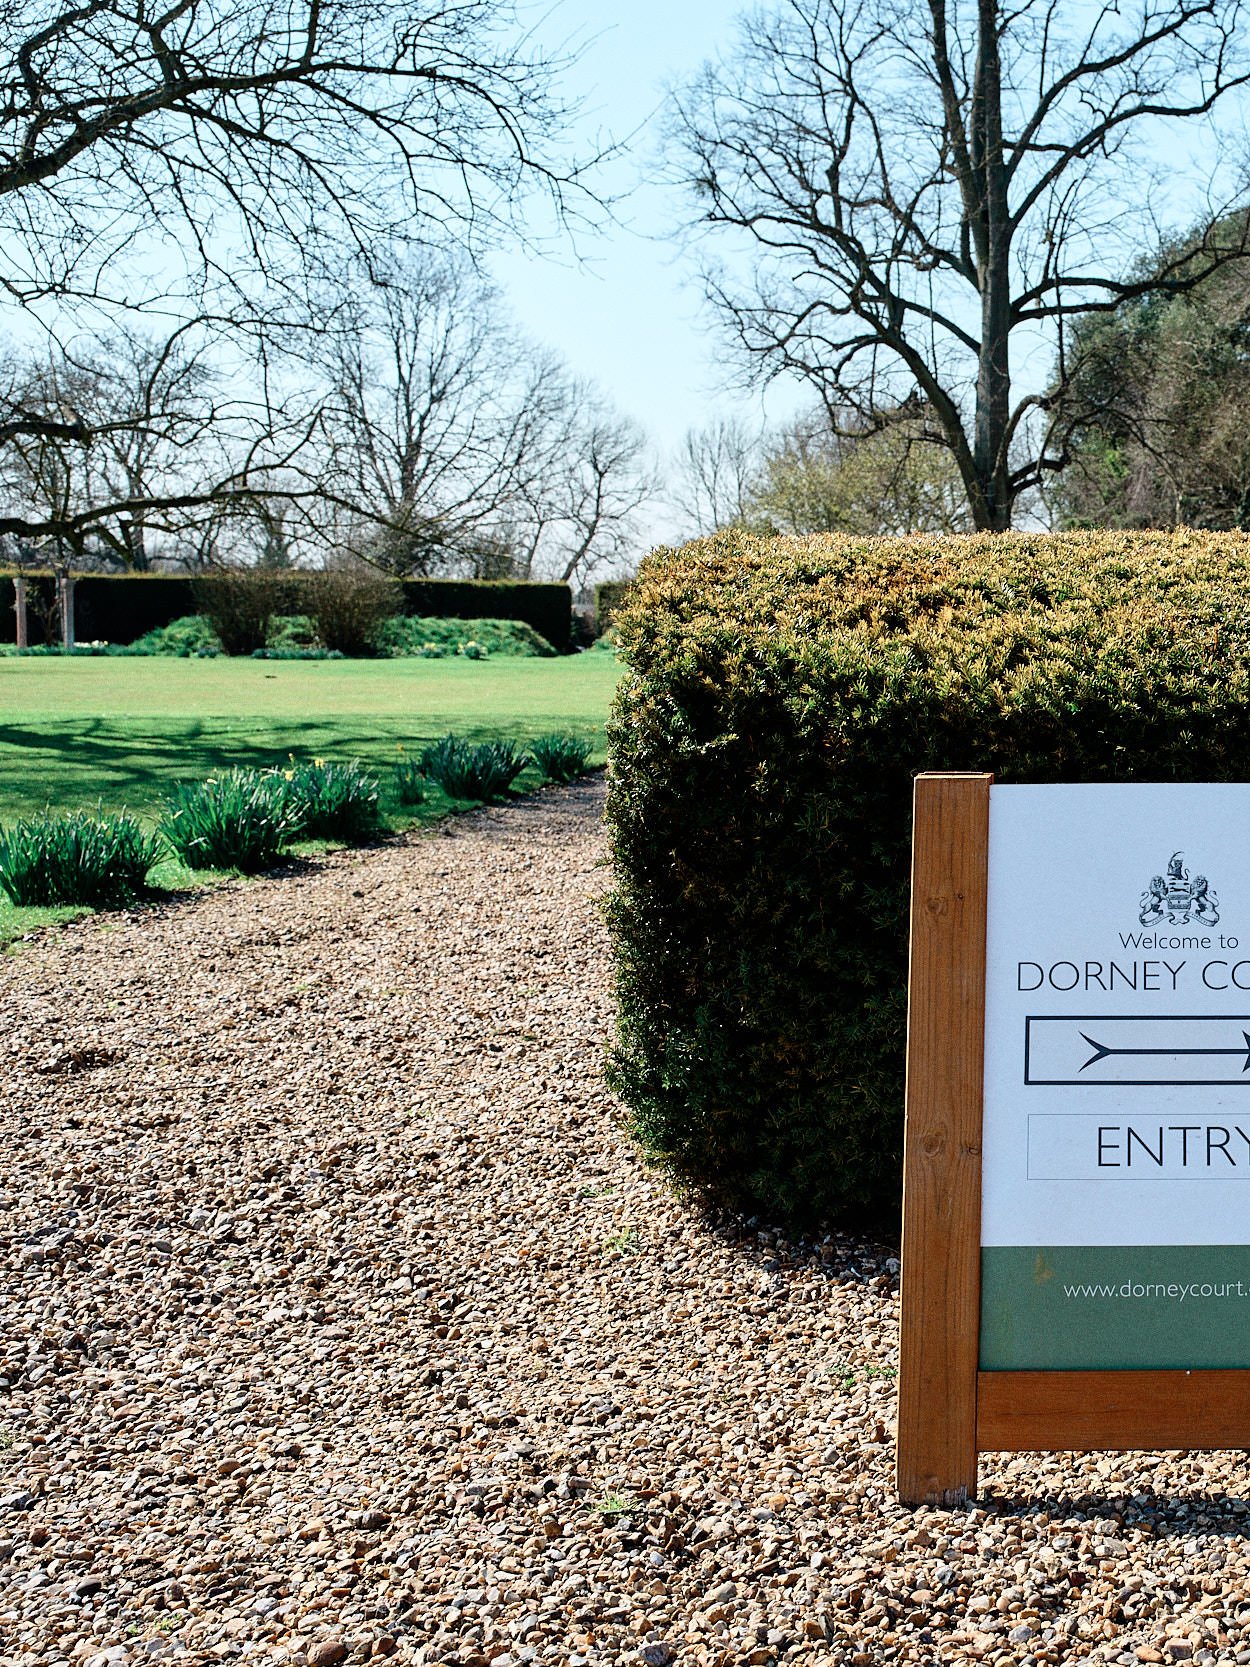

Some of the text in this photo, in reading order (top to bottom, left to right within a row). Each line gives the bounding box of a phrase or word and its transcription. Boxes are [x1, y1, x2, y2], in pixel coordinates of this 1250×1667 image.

[1118, 932, 1239, 950] Welcome to
[1017, 960, 1187, 992] DORNEY
